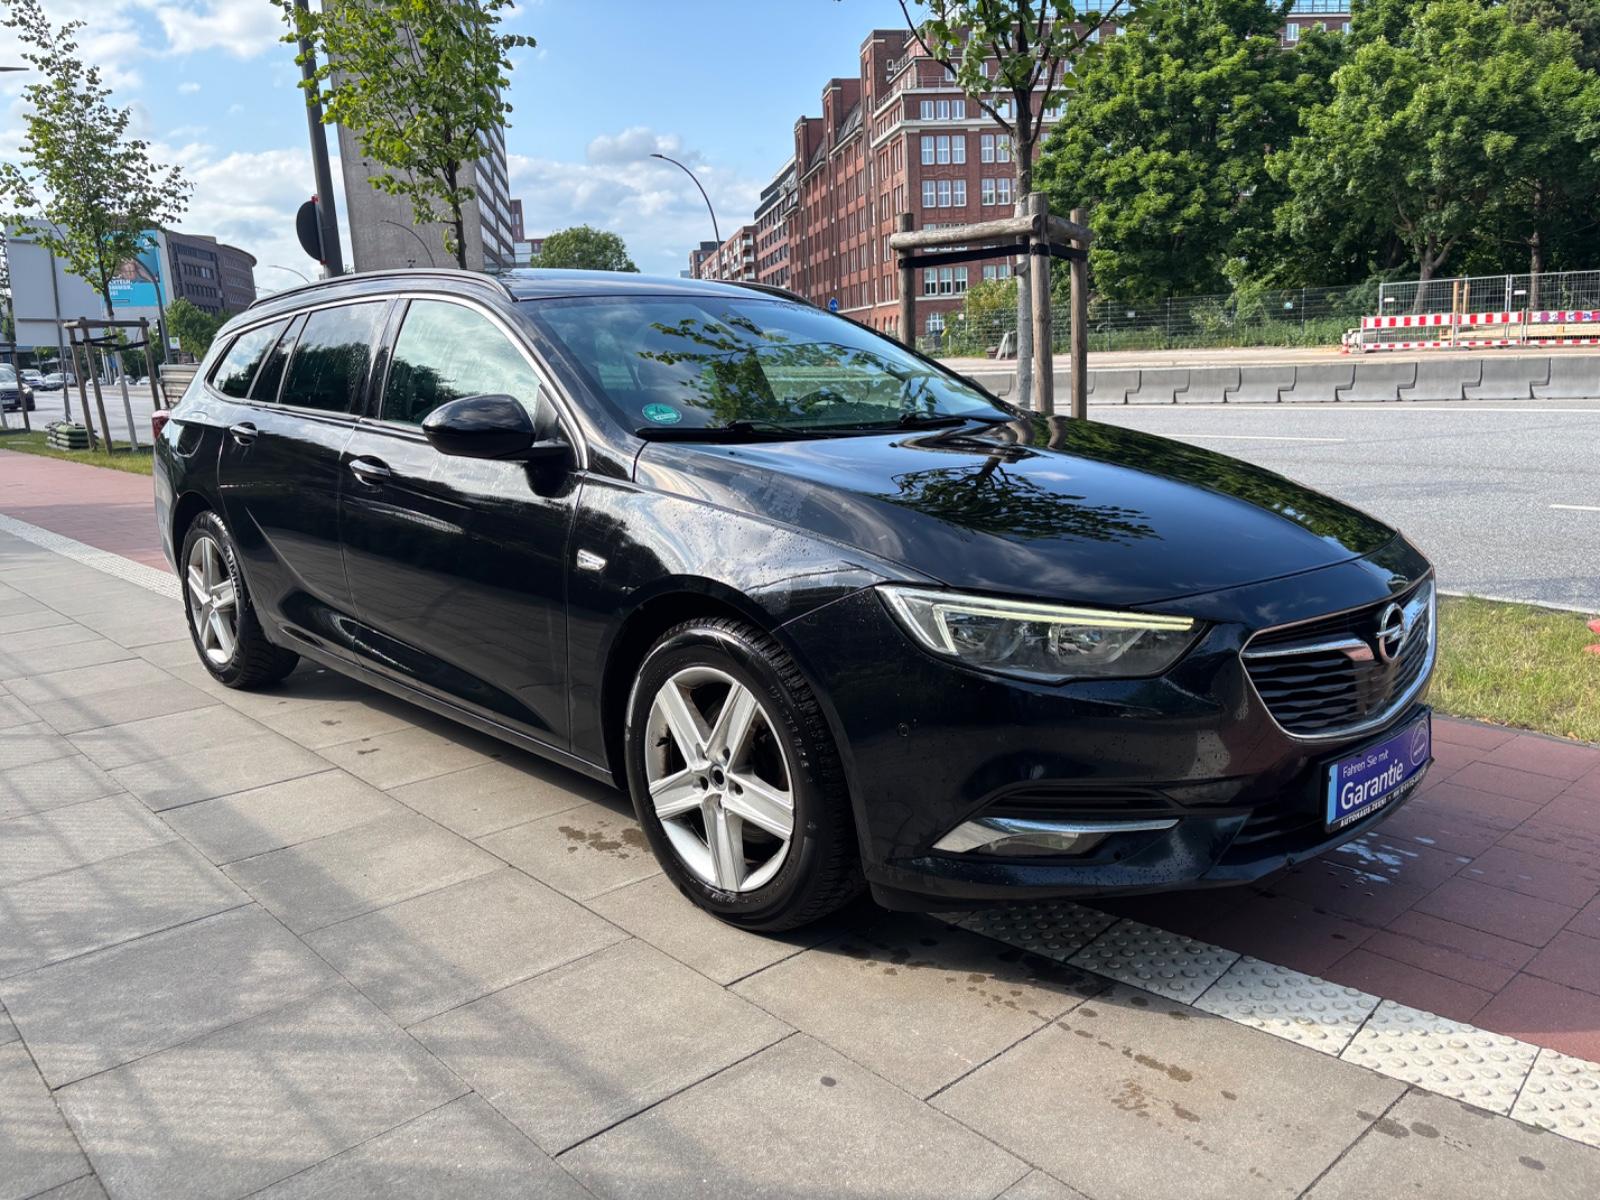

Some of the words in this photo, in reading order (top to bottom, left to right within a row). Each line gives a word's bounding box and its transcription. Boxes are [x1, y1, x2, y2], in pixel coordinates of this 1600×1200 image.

[1343, 761, 1366, 778] Fahren
[1367, 754, 1378, 768] Sie
[1378, 749, 1389, 762] mit
[1341, 759, 1404, 810] Garantie
